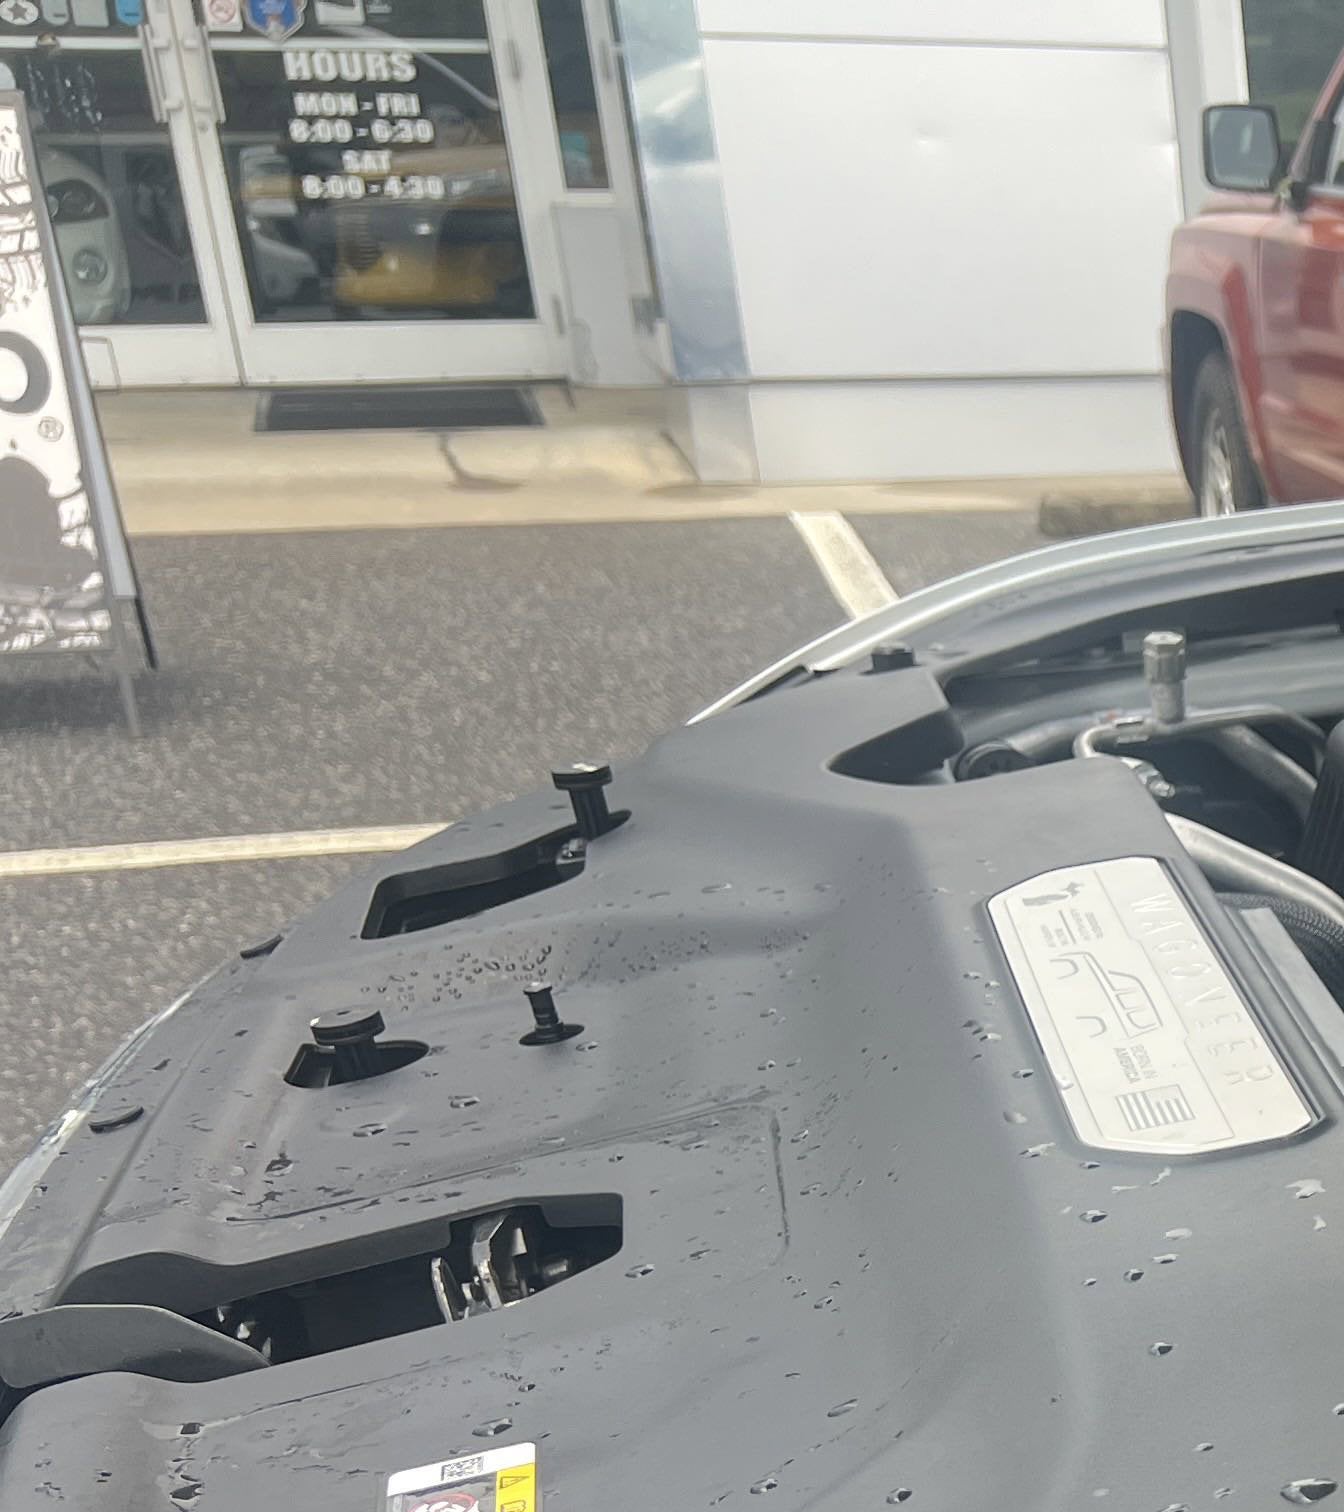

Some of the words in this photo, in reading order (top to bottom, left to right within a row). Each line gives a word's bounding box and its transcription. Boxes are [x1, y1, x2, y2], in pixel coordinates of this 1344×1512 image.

[283, 50, 417, 82] HOURS
[293, 91, 359, 117] MON
[375, 91, 421, 117] FRI
[342, 149, 392, 174] SAT
